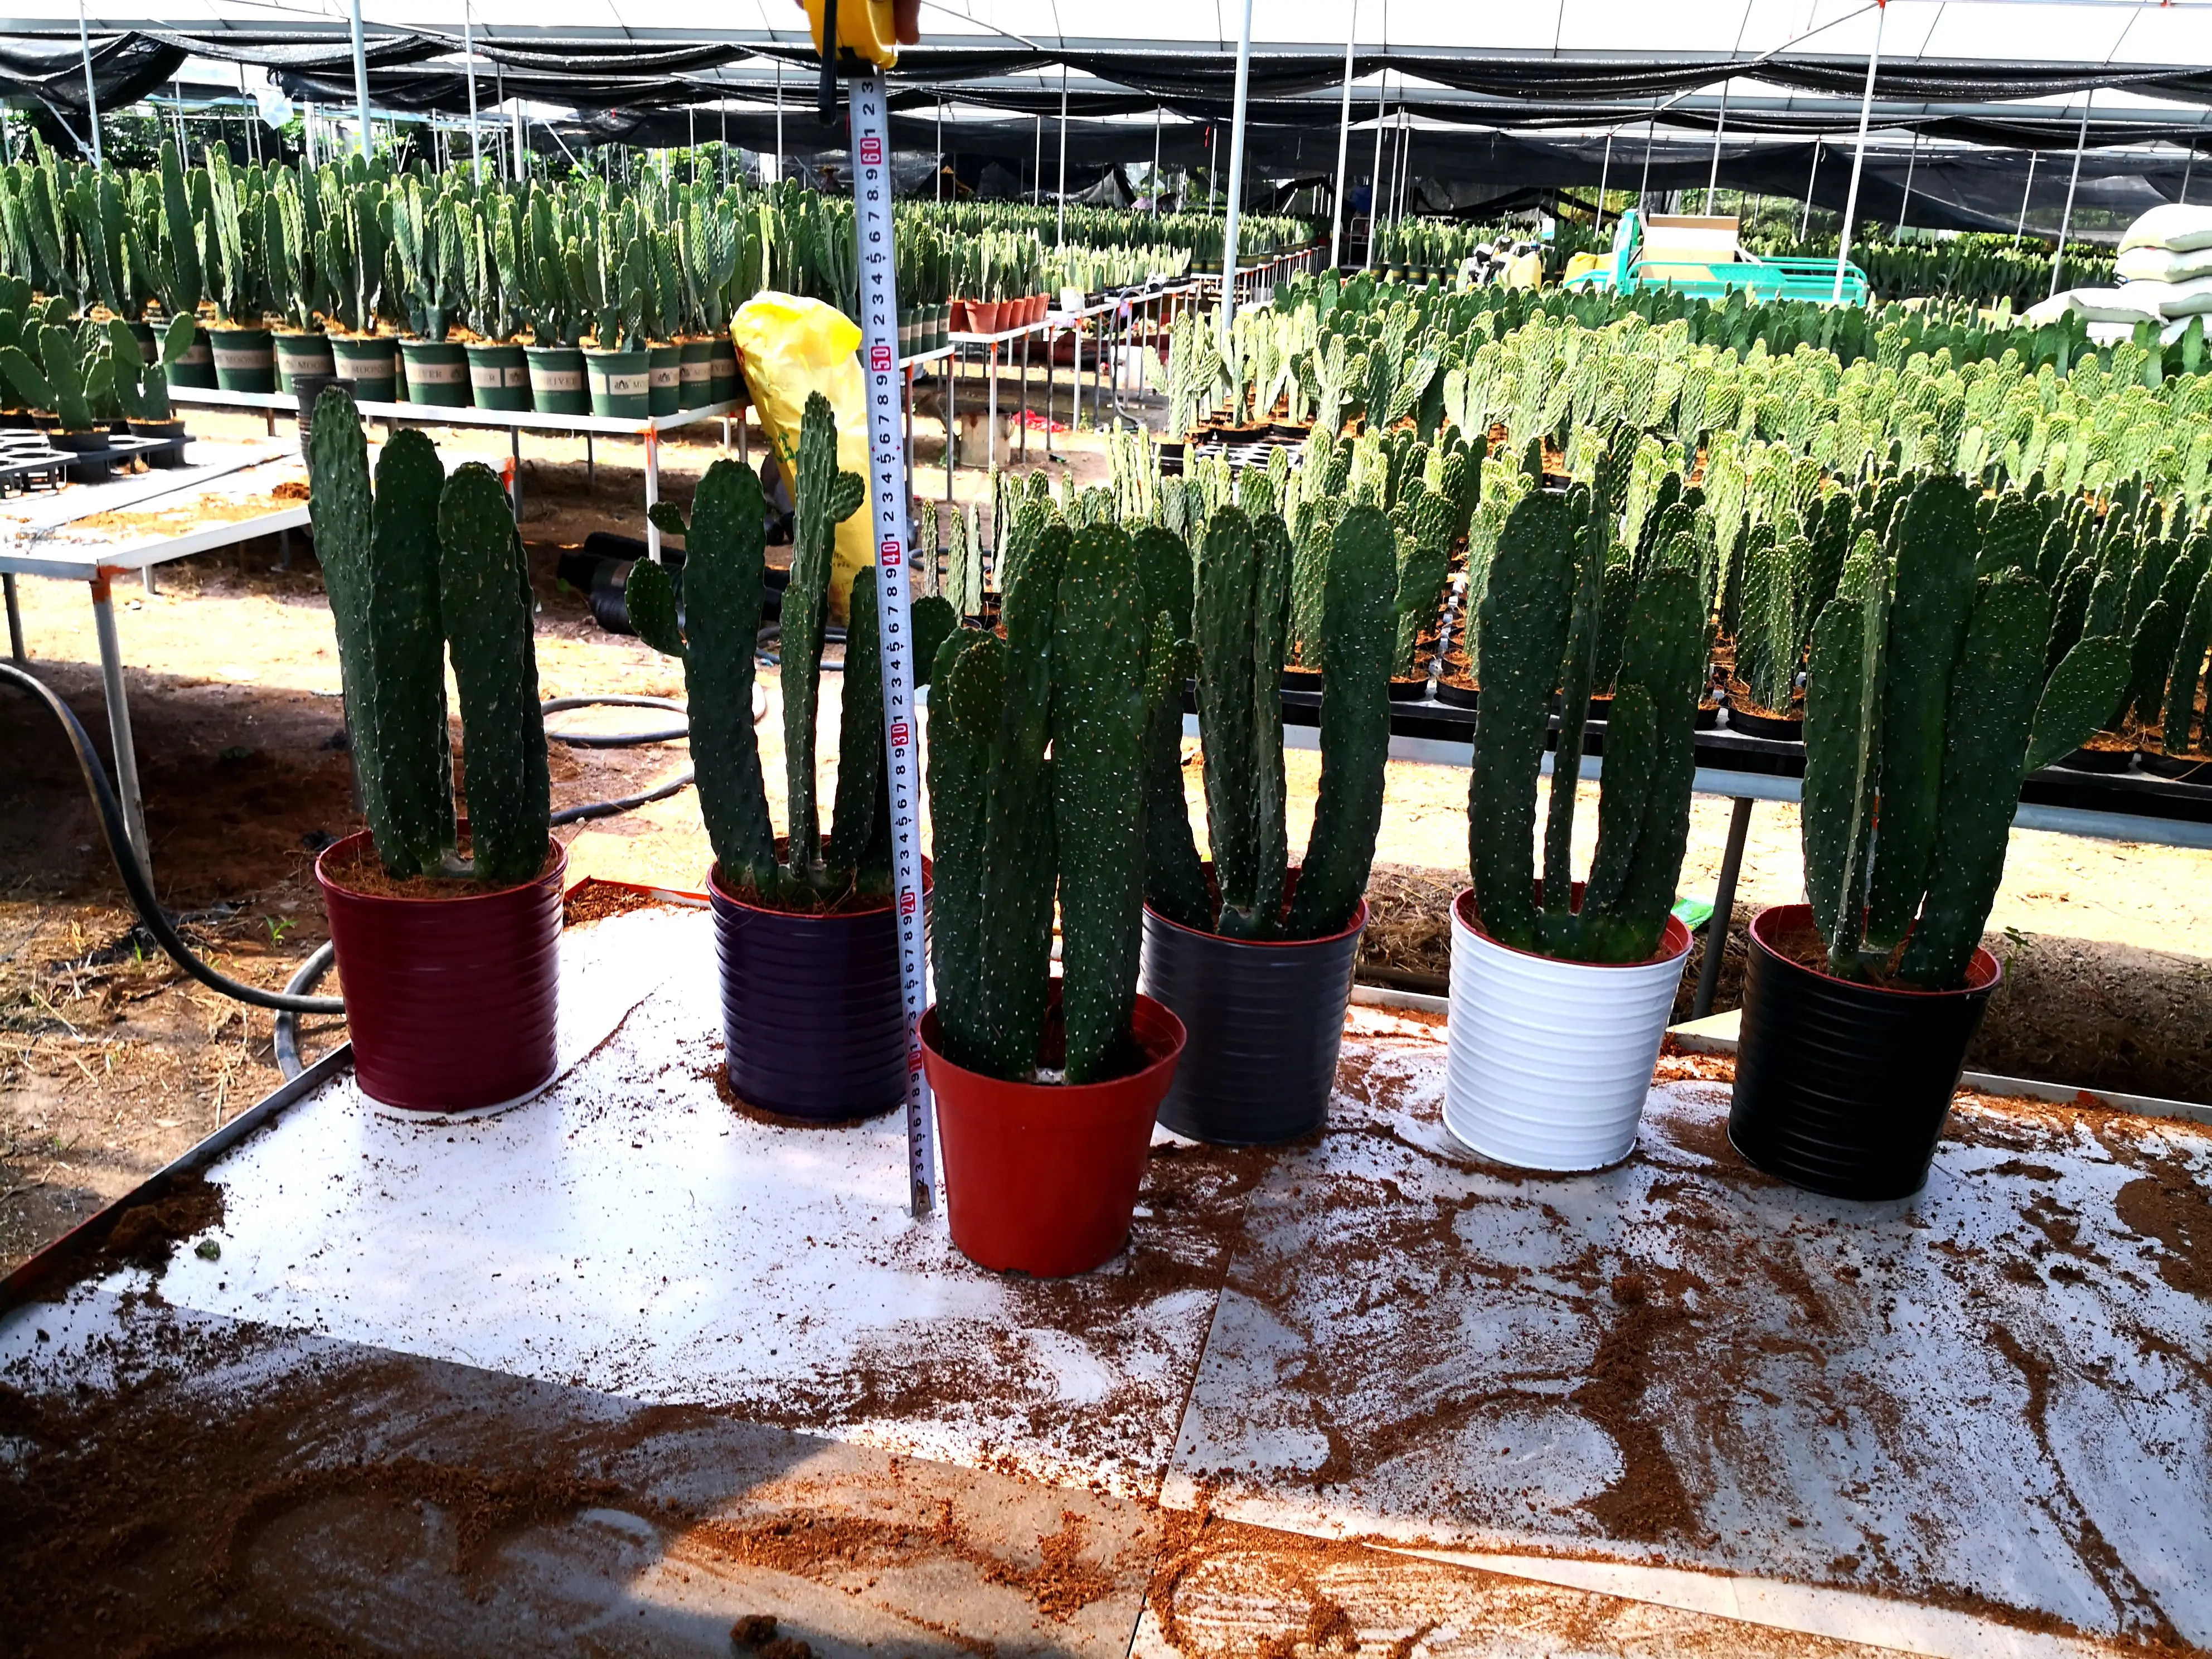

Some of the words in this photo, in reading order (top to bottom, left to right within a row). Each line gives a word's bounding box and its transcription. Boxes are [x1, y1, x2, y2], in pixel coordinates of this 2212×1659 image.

[862, 81, 873, 93] 3
[863, 104, 875, 115] 2
[864, 129, 876, 137] 1
[862, 140, 880, 163] 60
[866, 168, 877, 180] 9
[867, 190, 879, 201] 8
[869, 211, 880, 222] 7
[869, 231, 881, 242] 6
[870, 253, 882, 264] 5
[871, 273, 882, 285] 4
[872, 294, 884, 305] 3
[874, 314, 885, 325] 2
[875, 337, 886, 346] 1
[872, 348, 890, 370] 50
[876, 375, 887, 386] 9
[877, 394, 889, 405] 8
[879, 415, 890, 425] 7
[879, 433, 890, 444] 6
[880, 453, 891, 464] 5
[881, 472, 892, 484] 4
[882, 492, 893, 503] 3
[884, 511, 894, 522] 2
[885, 533, 895, 541] 1
[882, 542, 899, 564] 40
[886, 567, 897, 579] 9
[887, 586, 898, 597] 8
[888, 606, 899, 616] 7
[889, 623, 899, 634] 6
[890, 641, 900, 652] 5
[891, 659, 901, 670] 4
[891, 677, 902, 688] 3
[892, 695, 903, 706] 2
[892, 725, 908, 745] 30
[895, 748, 905, 758] 9
[896, 765, 906, 775] 8
[896, 783, 906, 793] 7
[898, 799, 907, 809] 6
[898, 816, 908, 827] 5
[899, 832, 909, 843] 4
[900, 850, 909, 860] 3
[901, 866, 910, 877] 2
[901, 885, 910, 893] 1
[901, 894, 914, 913] 20
[903, 915, 912, 926] 9
[904, 930, 913, 942] 8
[905, 949, 914, 959] 7
[905, 963, 914, 973] 6
[907, 979, 915, 989] 5
[907, 995, 916, 1005] 4
[908, 1011, 916, 1021] 3
[909, 1053, 921, 1071] 10
[911, 1073, 919, 1083] 9
[911, 1088, 920, 1097] 8
[913, 1104, 921, 1113] 7
[913, 1117, 921, 1127] 6
[914, 1132, 923, 1142] 5
[915, 1148, 923, 1157] 4
[915, 1162, 924, 1173] 3
[916, 1177, 924, 1187] 2
